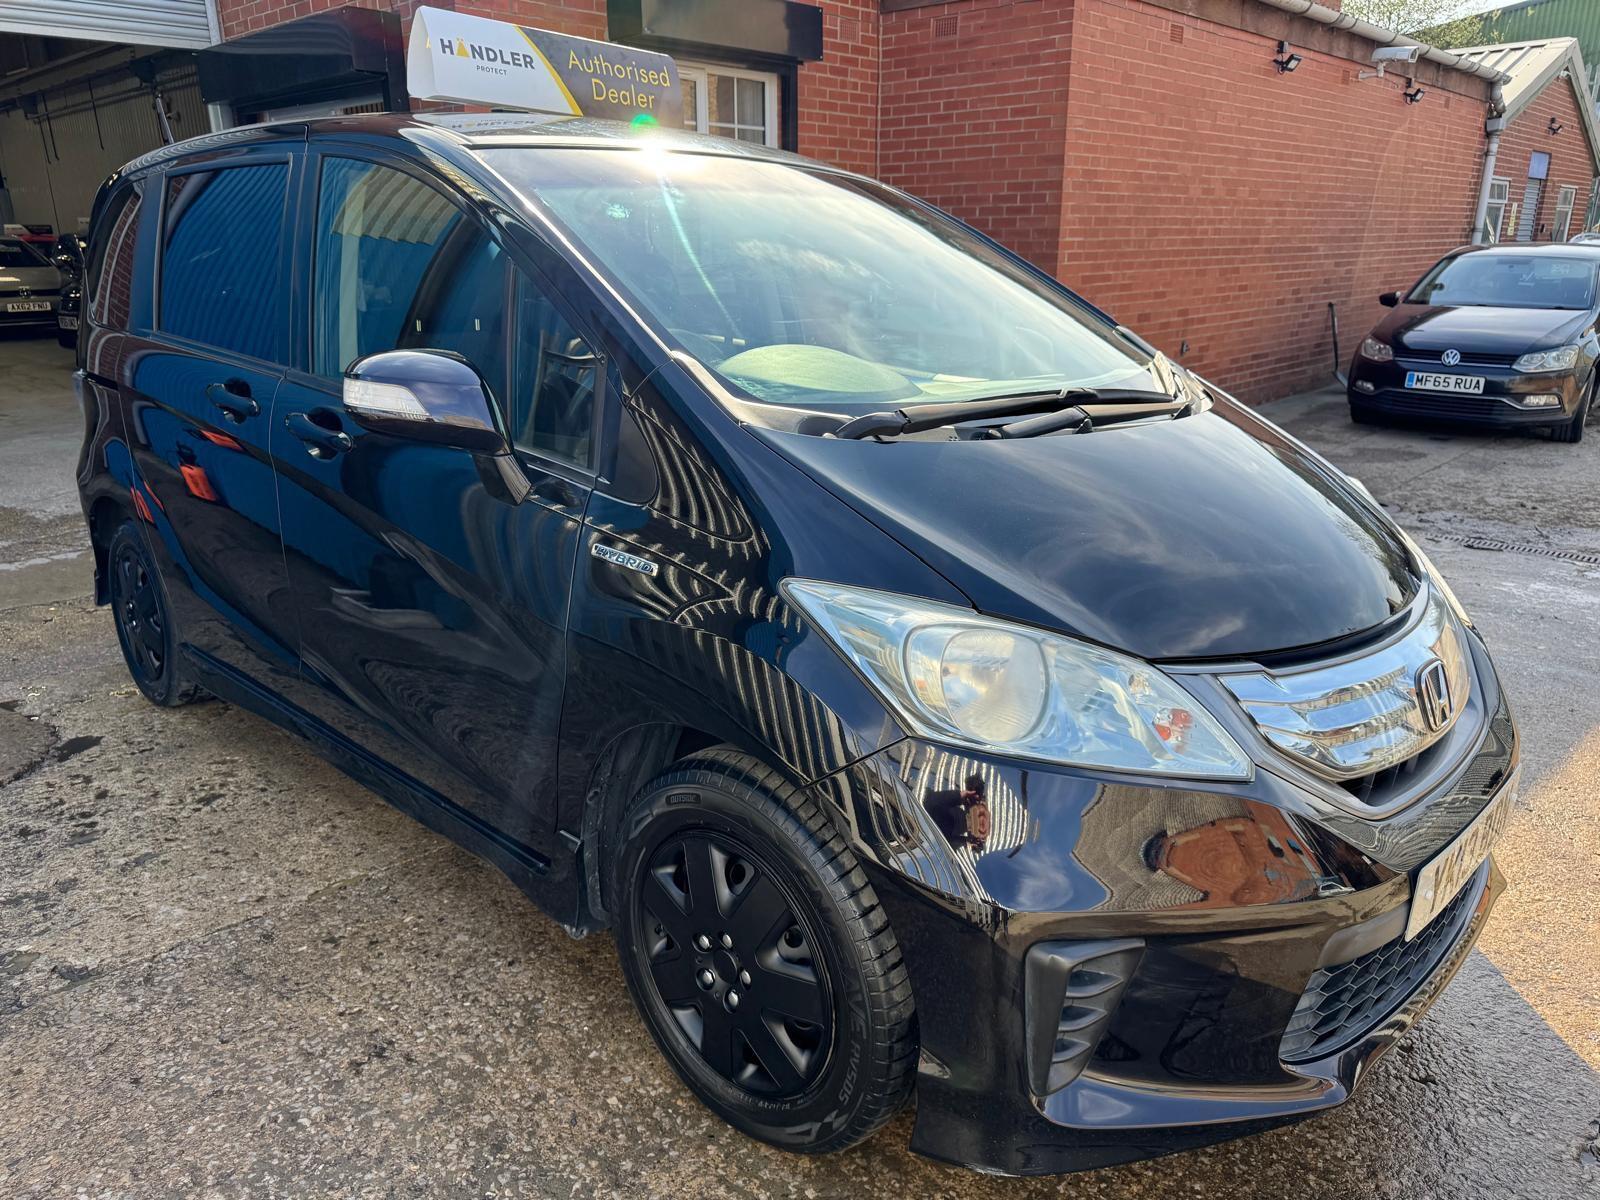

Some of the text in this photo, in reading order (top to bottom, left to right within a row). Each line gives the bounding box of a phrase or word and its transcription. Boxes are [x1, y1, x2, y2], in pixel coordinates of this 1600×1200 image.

[476, 65, 507, 76] PROTECT
[568, 50, 671, 88] Authorised
[591, 78, 655, 109] Dealer
[1414, 373, 1481, 392] MF65 RUA
[595, 545, 653, 573] HYBRID
